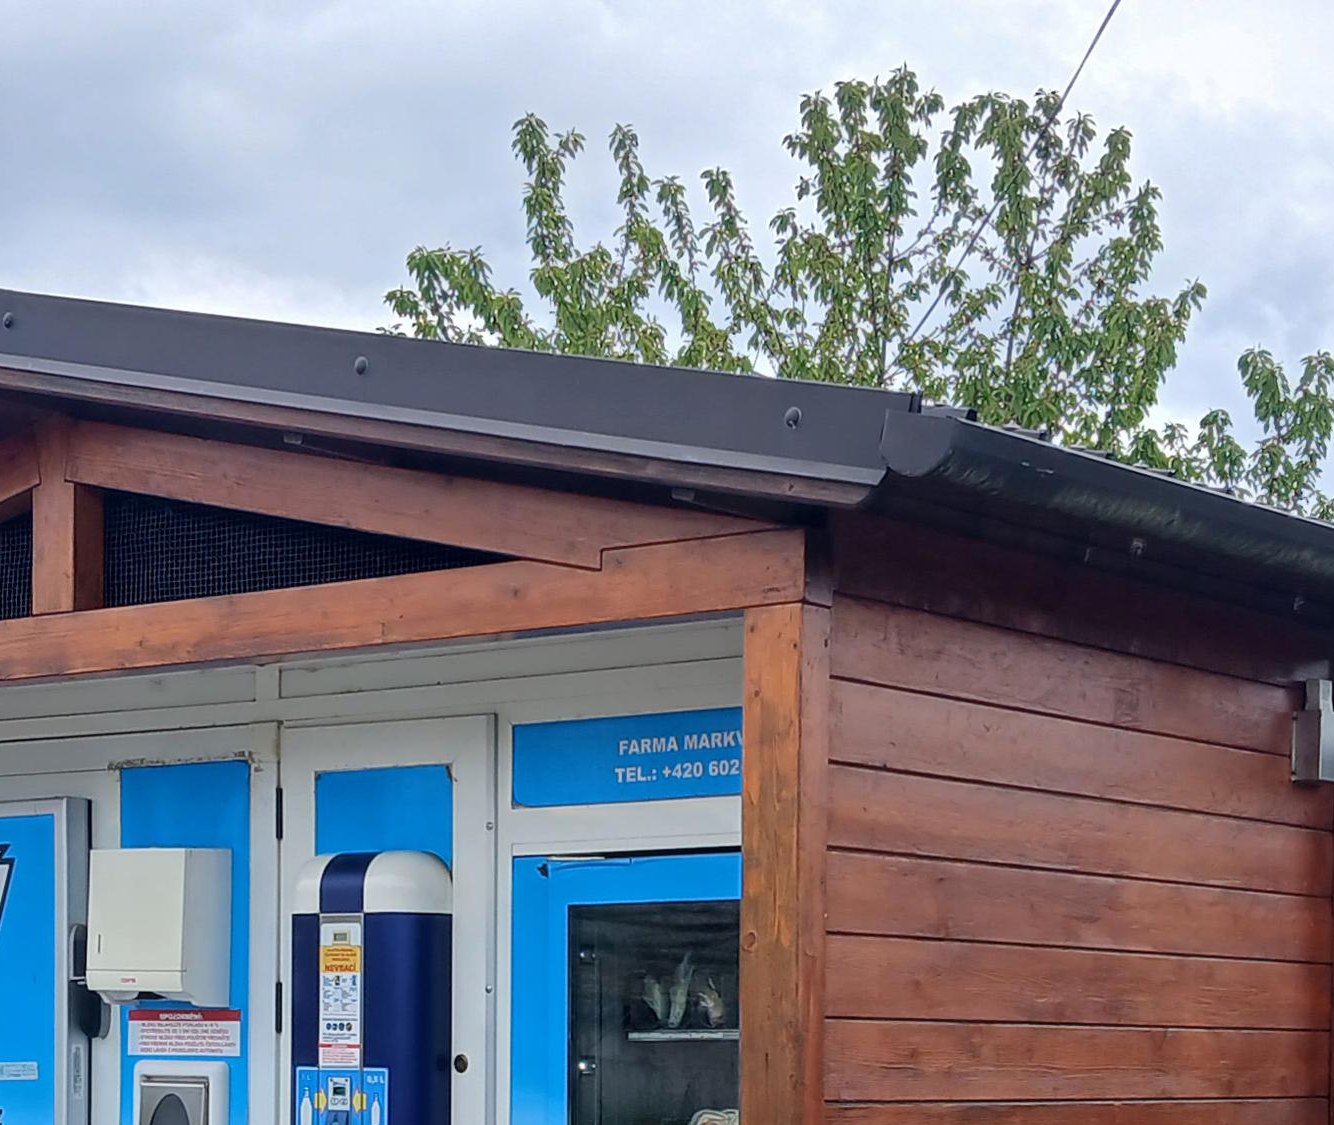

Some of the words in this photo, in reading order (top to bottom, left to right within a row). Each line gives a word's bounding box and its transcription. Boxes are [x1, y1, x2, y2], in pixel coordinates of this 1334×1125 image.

[619, 736, 679, 755] FARMA
[614, 766, 657, 783] TEL.:
[662, 762, 703, 778] +420
[708, 759, 740, 776] 602
